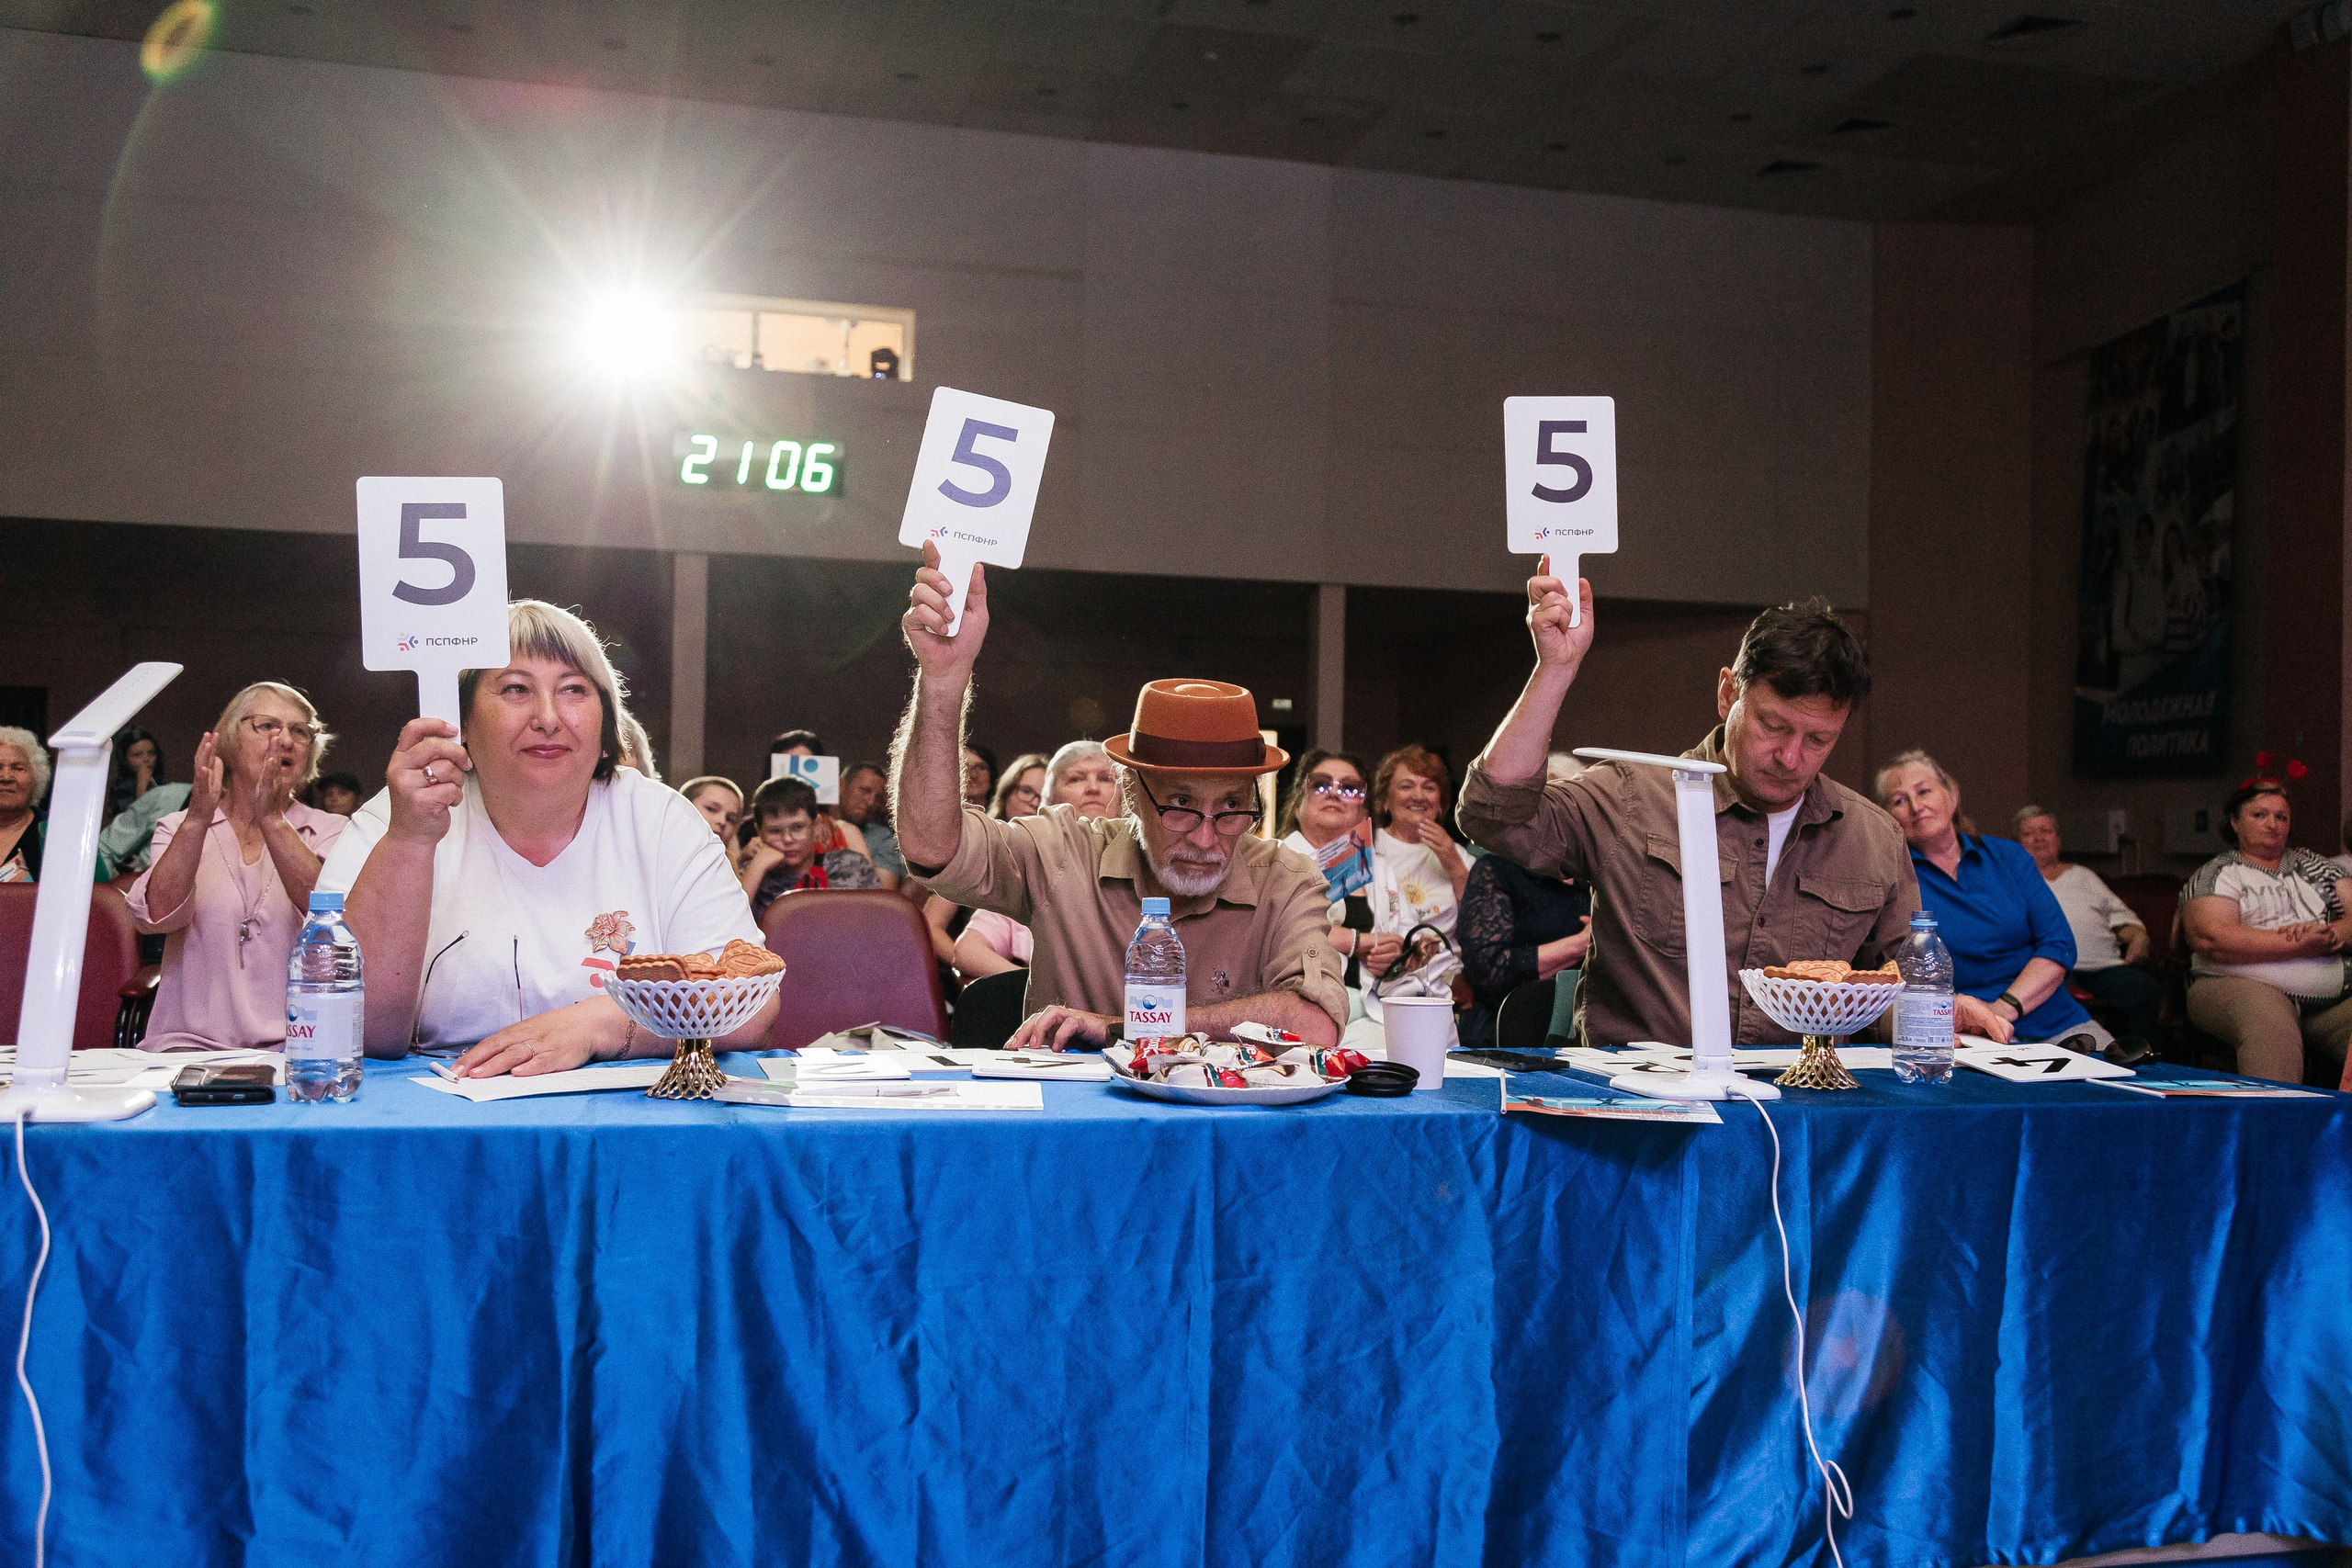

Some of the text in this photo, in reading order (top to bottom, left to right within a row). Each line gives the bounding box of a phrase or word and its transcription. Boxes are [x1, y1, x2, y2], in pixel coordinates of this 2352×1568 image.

[937, 417, 1019, 508] 5
[1531, 420, 1593, 503] 5
[953, 531, 998, 547] ПСПФНР
[1555, 528, 1594, 536] ПСПФНР
[391, 502, 476, 606] 5
[425, 637, 478, 647] ПСПФНР
[2125, 730, 2210, 757] ПОЛИТИКА
[1129, 1010, 1173, 1023] TASSAY
[1988, 1056, 2072, 1073] 4
